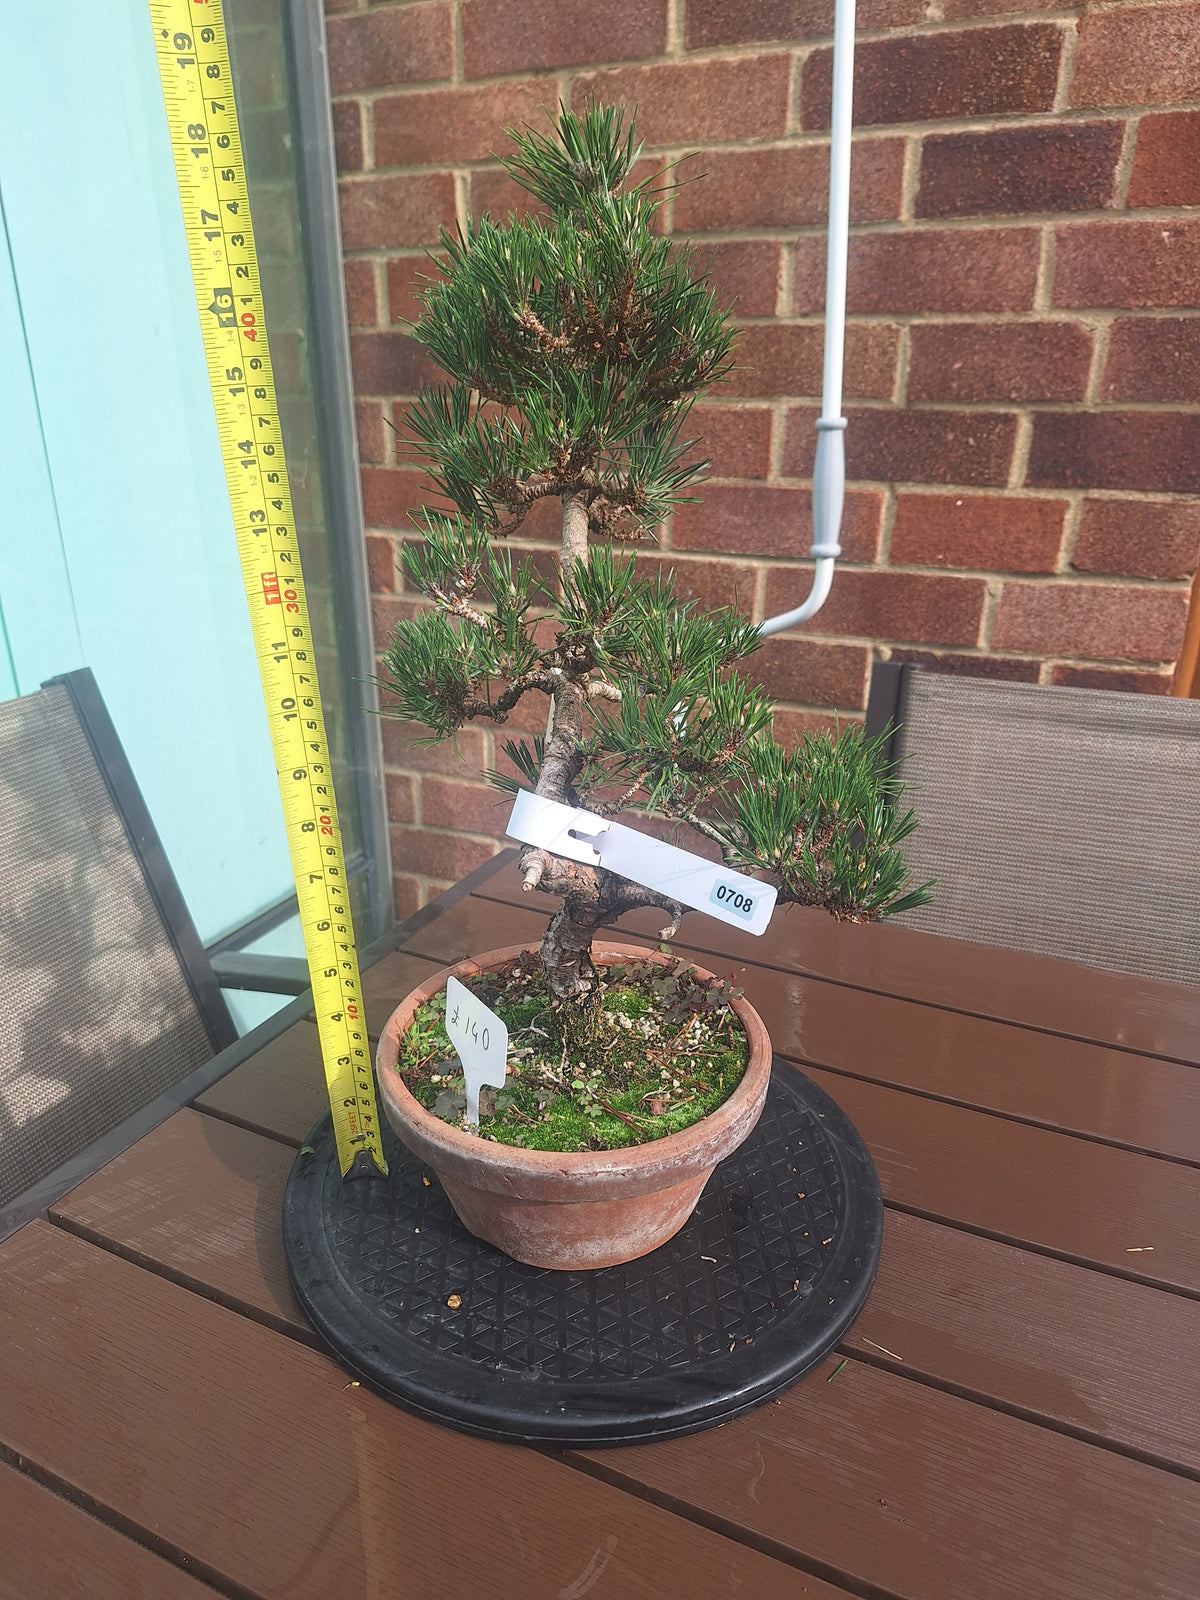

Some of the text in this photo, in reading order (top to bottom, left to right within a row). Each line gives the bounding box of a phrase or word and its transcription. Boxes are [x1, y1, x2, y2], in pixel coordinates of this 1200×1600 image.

[201, 27, 215, 43] 9
[173, 32, 195, 69] 19
[206, 64, 220, 79] 8
[211, 101, 225, 114] 7
[188, 123, 208, 158] 18
[217, 135, 230, 148] 6
[221, 169, 235, 182] 5
[226, 201, 239, 215] 4
[201, 209, 221, 242] 17
[231, 234, 244, 247] 3
[236, 266, 249, 278] 2
[241, 297, 252, 305] 1
[216, 294, 234, 322] 16
[241, 313, 257, 342] 40
[250, 358, 262, 370] 9
[226, 366, 245, 397] 15
[254, 387, 266, 399] 8
[259, 416, 271, 428] 7
[238, 440, 256, 469] 14
[263, 444, 275, 456] 6
[268, 473, 279, 484] 5
[272, 499, 283, 511] 4
[249, 509, 267, 537] 13
[276, 526, 287, 537] 3
[280, 552, 292, 563] 2
[284, 589, 299, 613] 30
[292, 628, 303, 637] 9
[271, 642, 288, 663] 11
[296, 651, 306, 661] 8
[299, 675, 310, 684] 7
[303, 698, 314, 707] 6
[281, 698, 297, 721] 10
[307, 721, 317, 730] 5
[310, 743, 320, 752] 4
[293, 769, 307, 780] 9
[314, 765, 324, 773] 3
[316, 786, 327, 795] 2
[301, 822, 315, 832] 8
[320, 815, 333, 836] 20
[326, 847, 336, 855] 9
[329, 867, 339, 876] 8
[310, 874, 323, 884] 7
[716, 885, 753, 913] 0708
[335, 906, 344, 914] 6
[317, 921, 330, 931] 6
[338, 925, 347, 933] 5
[340, 944, 349, 952] 4
[343, 962, 352, 970] 3
[324, 968, 337, 977] 5
[345, 980, 355, 988] 2
[331, 1013, 343, 1022] 4
[347, 1005, 358, 1020] 10
[337, 1057, 350, 1066] 3
[359, 1082, 368, 1090] 6
[343, 1098, 356, 1107] 2
